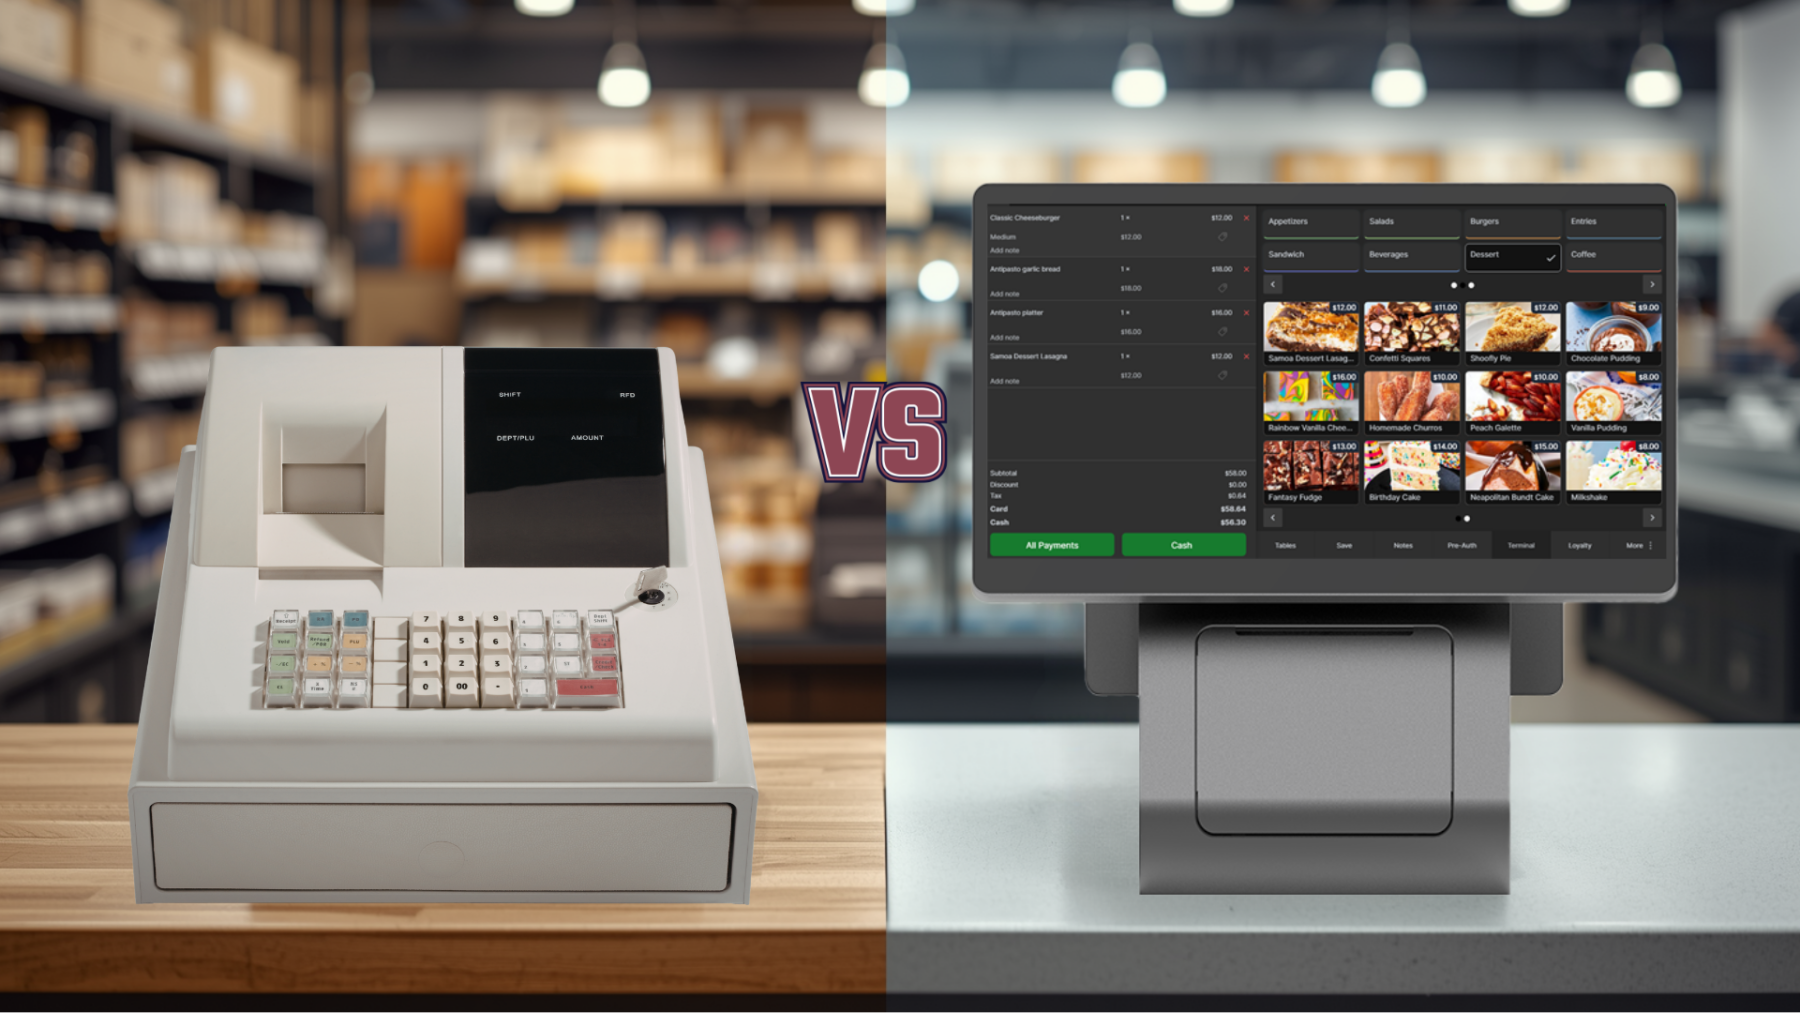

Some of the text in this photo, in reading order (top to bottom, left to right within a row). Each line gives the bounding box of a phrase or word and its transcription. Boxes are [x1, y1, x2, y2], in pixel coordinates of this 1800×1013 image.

[1268, 218, 1308, 226] Appetizers
[1470, 218, 1499, 226] Burgers
[1369, 251, 1408, 259] Beverages
[1333, 304, 1356, 312] $12.00
[1435, 304, 1457, 312] $11.00
[1534, 304, 1558, 312] $12.00
[1268, 354, 1294, 362] Samoa
[1296, 354, 1324, 362] Dessert
[1369, 354, 1431, 364] Confetti Squares
[1470, 354, 1512, 364] Shoofly Pie
[1571, 354, 1641, 364] Chocolate Pudding
[1268, 424, 1300, 432] Rainbow
[1302, 424, 1325, 432] Vanilla
[1369, 424, 1442, 432] Homemade Churros
[1470, 424, 1522, 432] Peach Galette
[1571, 424, 1627, 433] Vanilla Pudding
[1433, 443, 1457, 451] $14.00
[1535, 443, 1558, 451] $15.00
[1638, 443, 1661, 451] $8.00
[1268, 494, 1322, 502] Fantasy Fudge
[1369, 494, 1400, 502] Birthday
[1470, 493, 1554, 503] Neapolitan Bundt Cake
[1038, 542, 1079, 551] Payments
[1171, 541, 1192, 549] Cash
[1276, 542, 1296, 550] Tables
[1337, 542, 1352, 550] Save
[1394, 541, 1413, 550] Notes
[1448, 542, 1477, 550] Pre-Auth
[1508, 542, 1535, 550] Terminal
[1568, 541, 1592, 550] Loyalty
[1626, 541, 1643, 550] More
